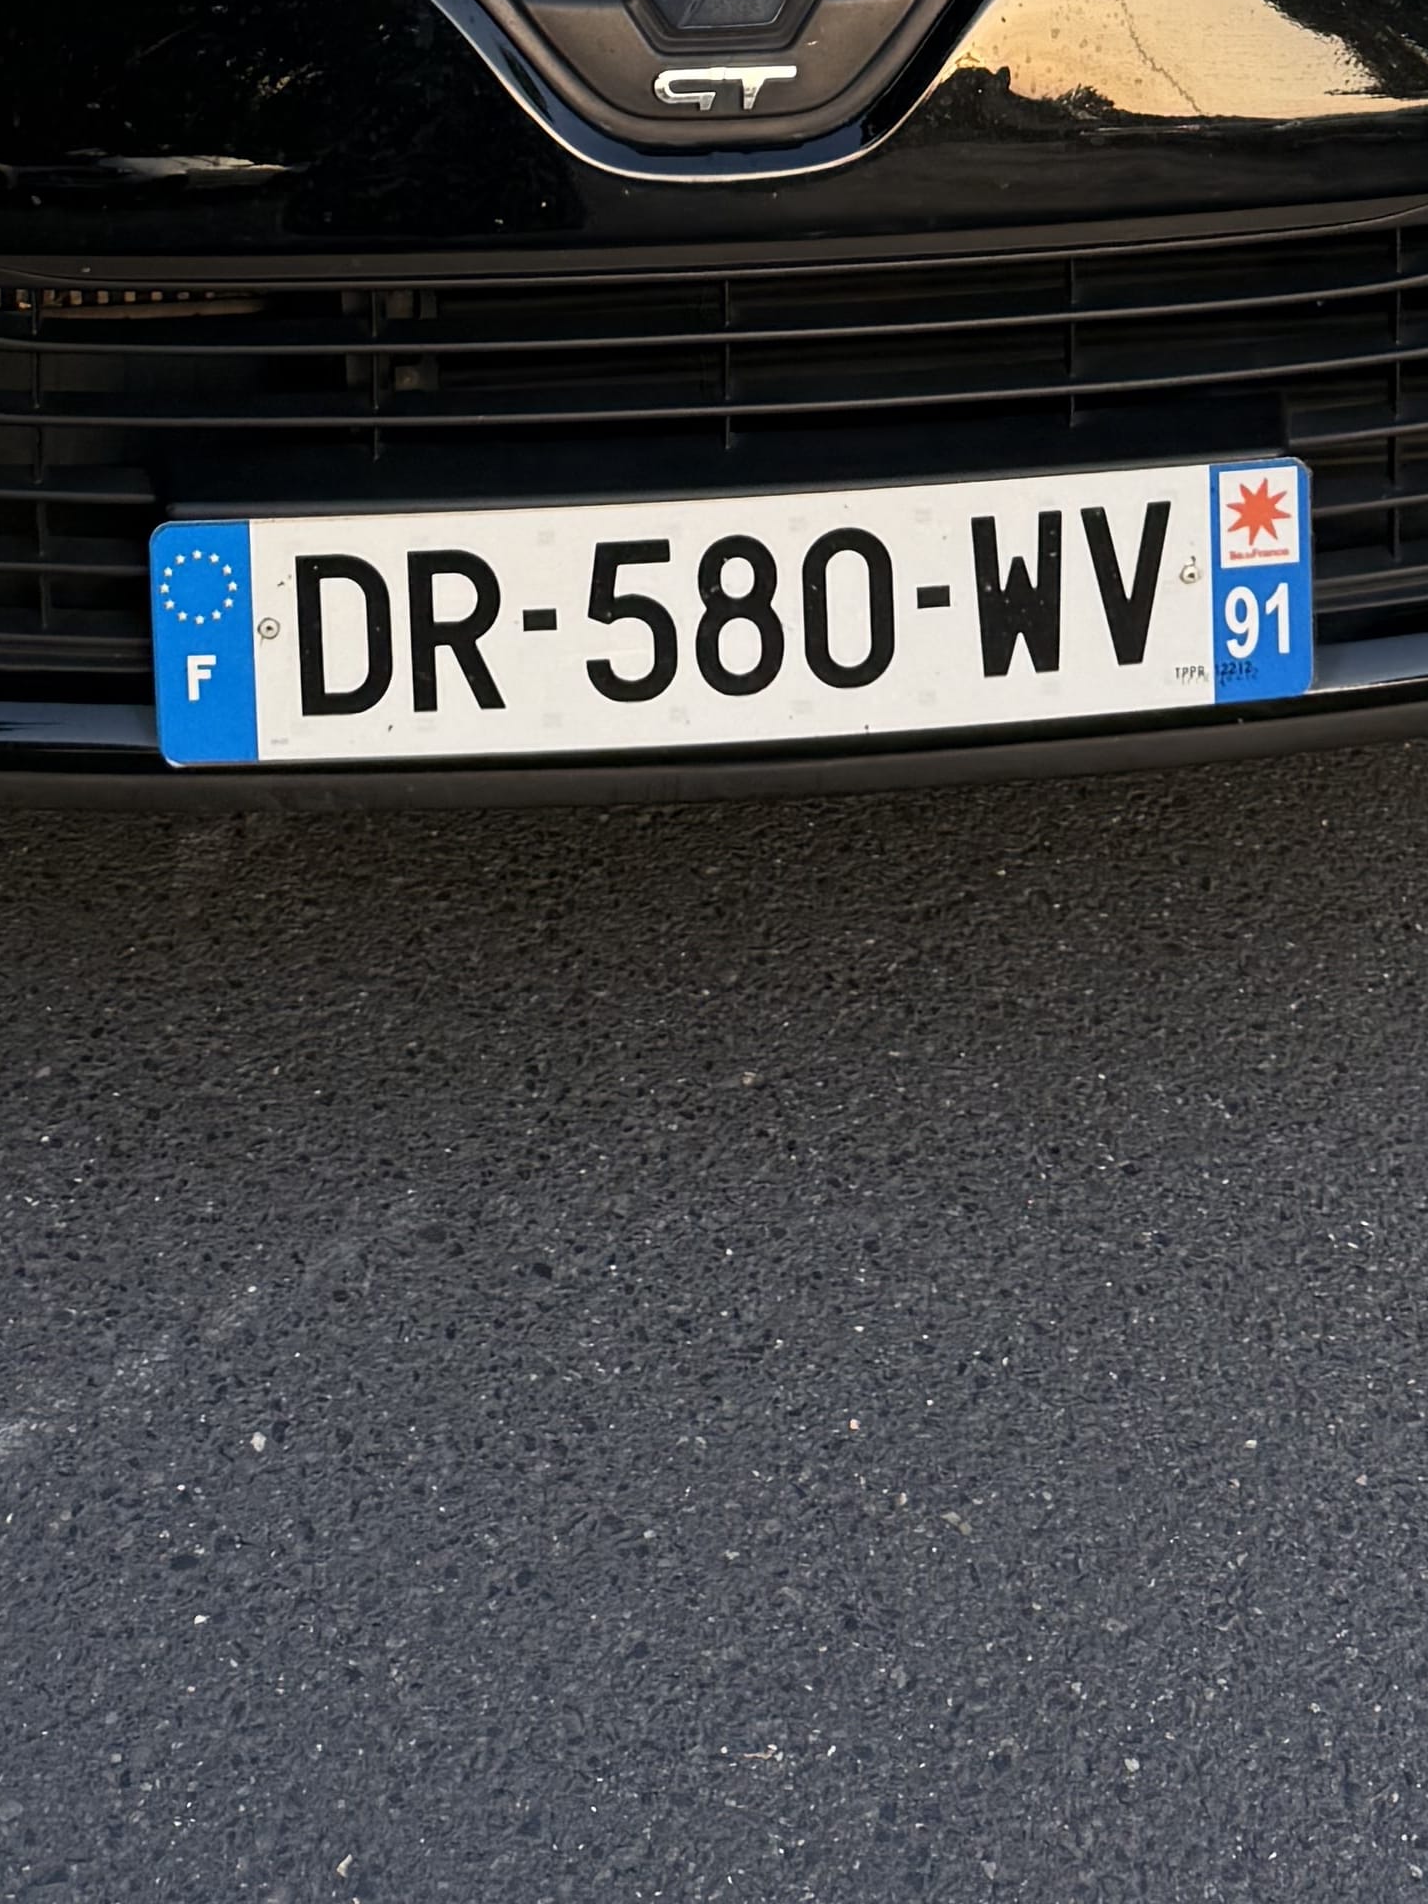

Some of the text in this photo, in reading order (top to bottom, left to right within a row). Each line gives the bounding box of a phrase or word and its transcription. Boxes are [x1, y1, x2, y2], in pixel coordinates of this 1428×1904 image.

[653, 65, 798, 111] GT
[295, 500, 1171, 718] DR-580-WV
[1224, 582, 1291, 659] 91
[186, 654, 218, 702] F
